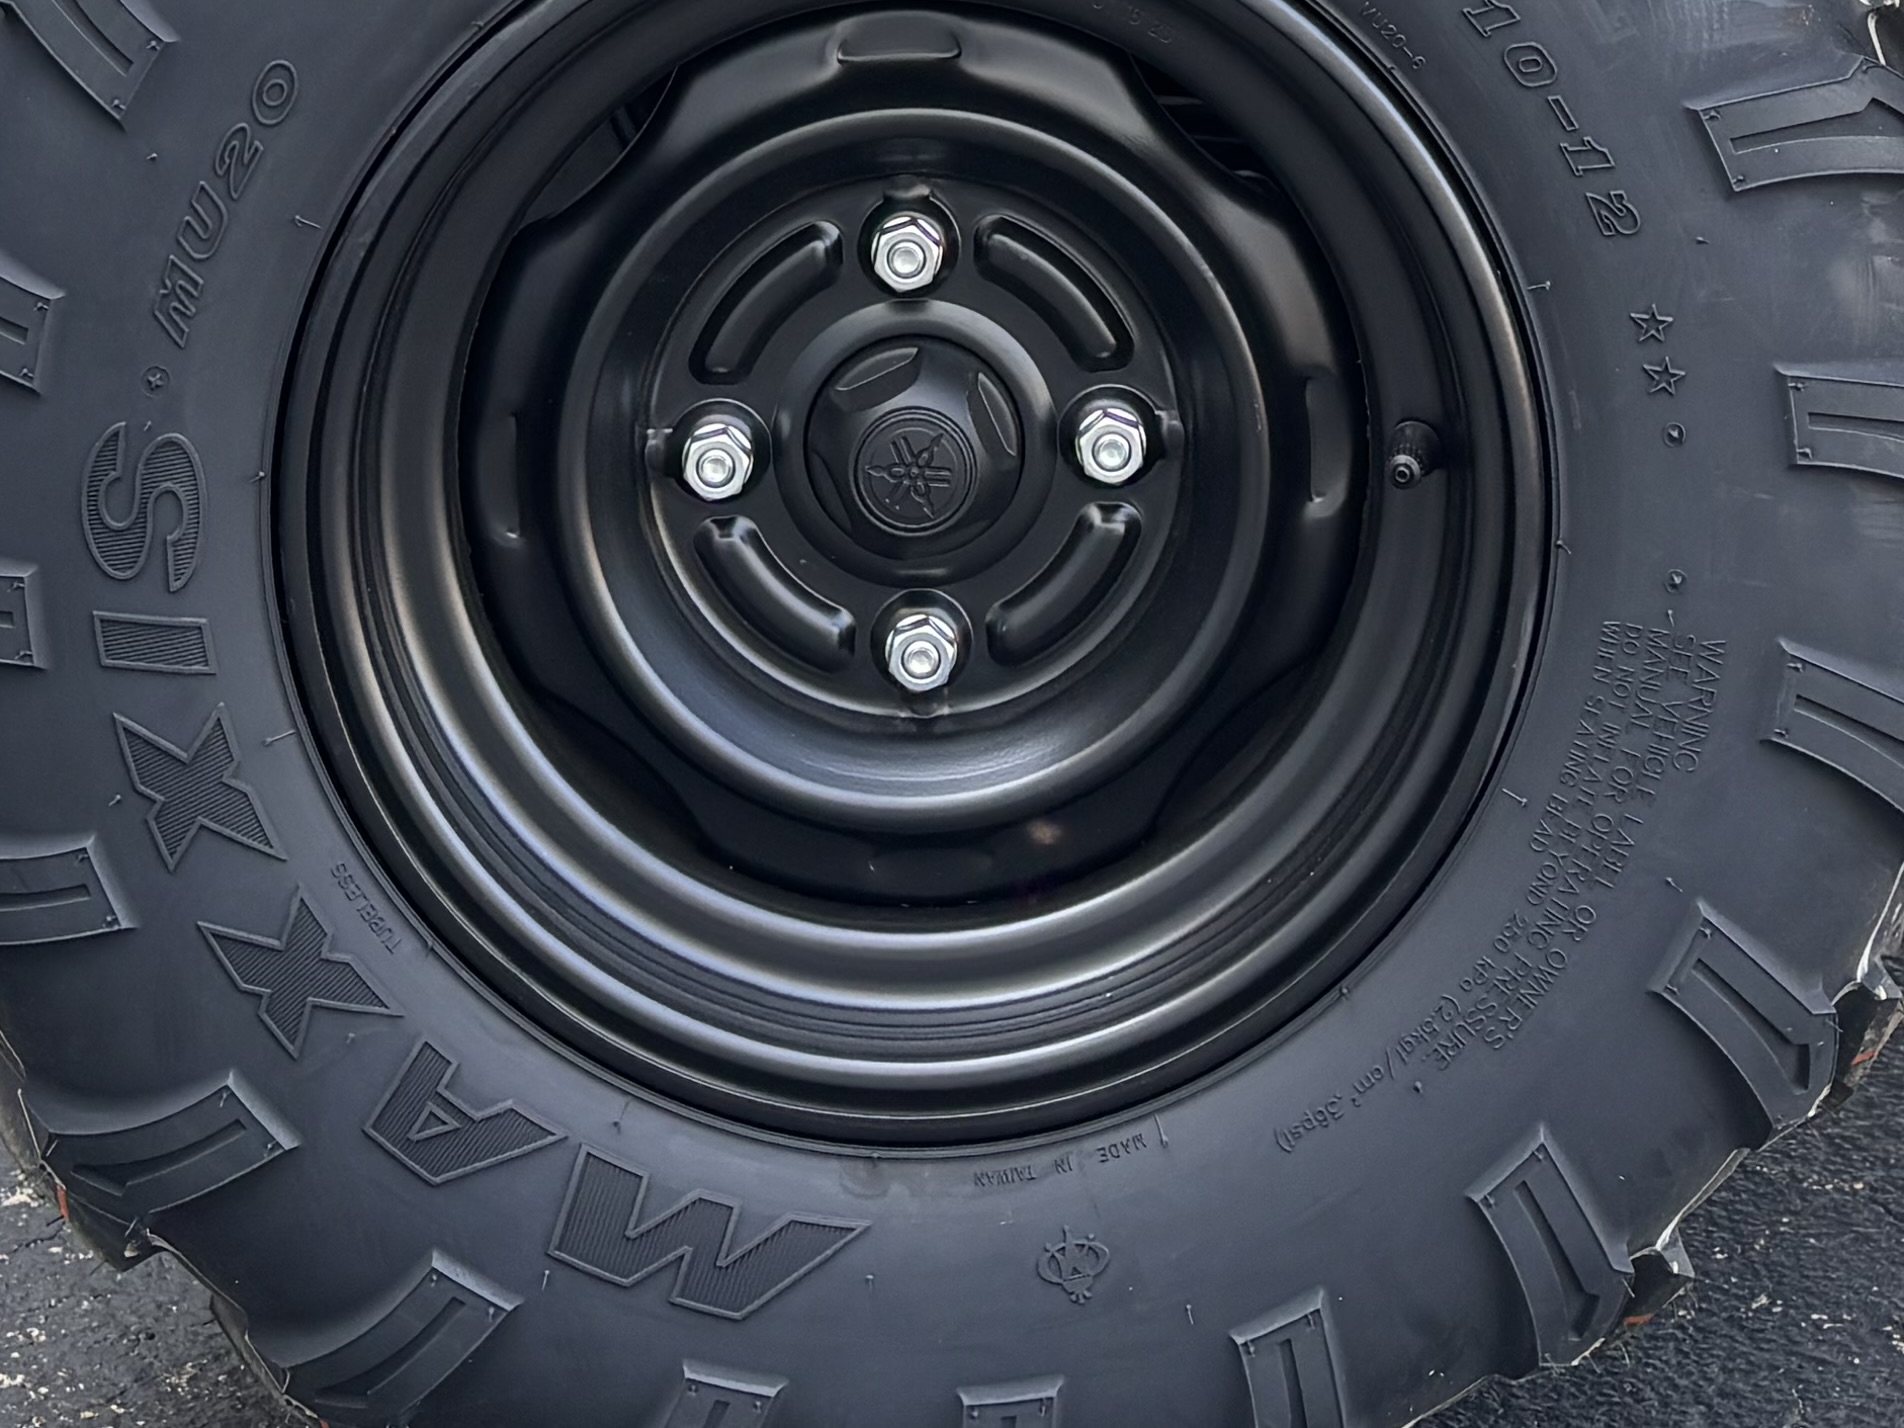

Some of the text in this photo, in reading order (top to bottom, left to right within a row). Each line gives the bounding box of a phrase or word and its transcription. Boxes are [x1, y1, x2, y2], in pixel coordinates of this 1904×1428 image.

[151, 59, 300, 350] MU20
[1621, 621, 1645, 656] DO
[1672, 639, 1727, 773] WARNING
[80, 421, 873, 1322] MAXXIS
[329, 862, 404, 956] TUBELESS
[1494, 908, 1529, 954] 250
[1561, 904, 1597, 942] OR
[973, 1132, 1148, 1188] MADE IN TAIWAN
